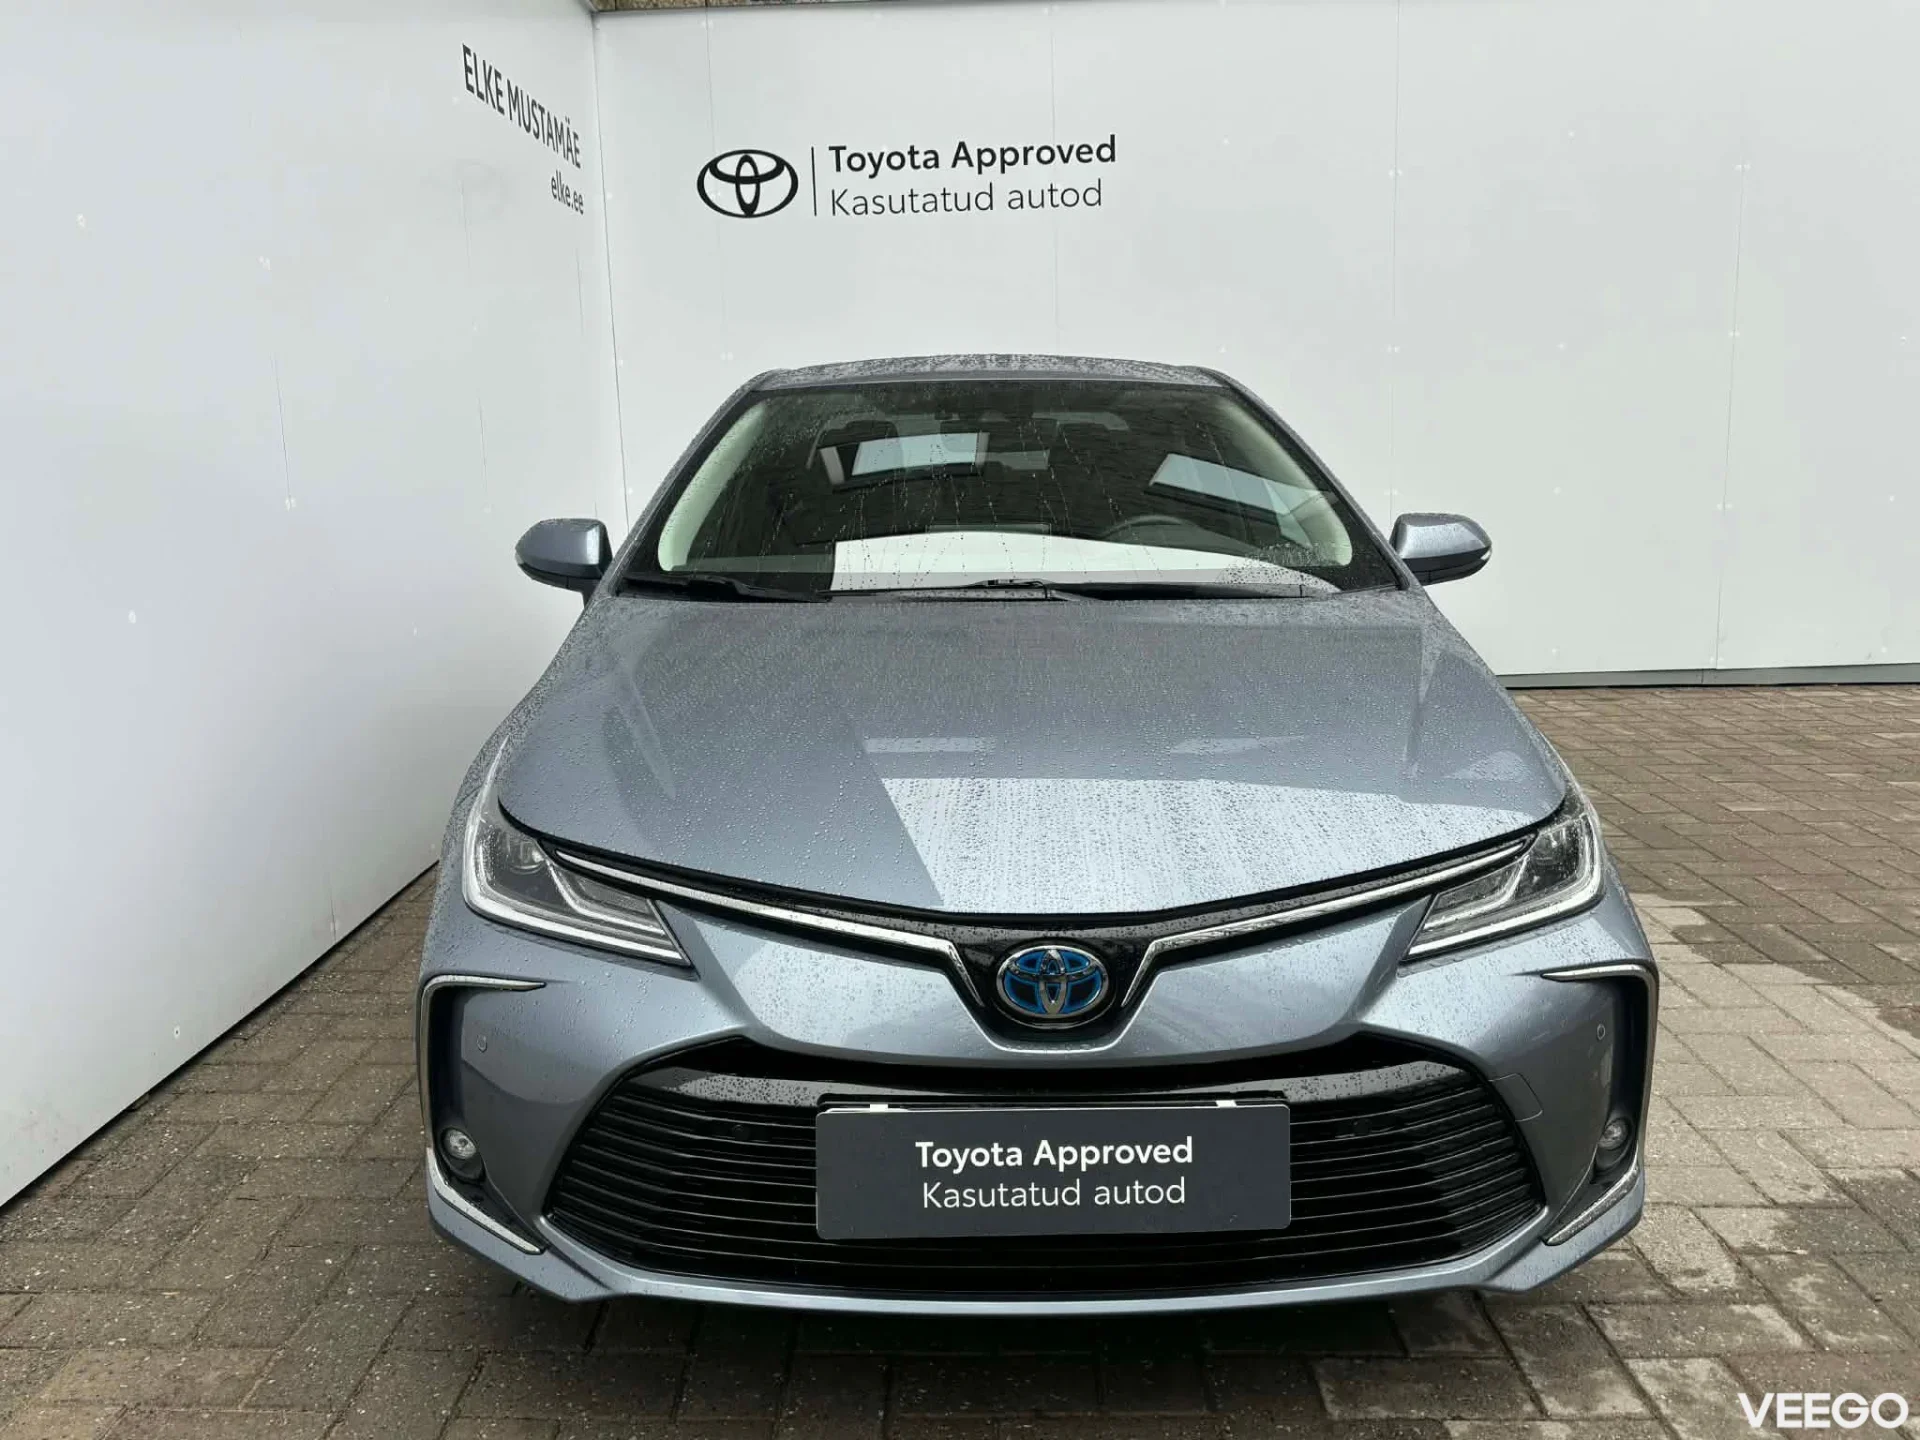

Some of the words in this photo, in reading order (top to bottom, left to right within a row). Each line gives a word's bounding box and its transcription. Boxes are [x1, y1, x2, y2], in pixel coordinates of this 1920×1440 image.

[462, 43, 505, 116] ELKE
[507, 78, 581, 169] MUSTAMÄE
[828, 145, 940, 178] Toyota
[951, 134, 1117, 174] Approved
[551, 169, 584, 215] elke.ee
[831, 182, 994, 216] Kasutatud
[1007, 178, 1102, 210] autod
[915, 1140, 1023, 1174] Toyota
[1033, 1136, 1193, 1172] Approved
[923, 1178, 1081, 1209] Kasutatud
[1094, 1177, 1186, 1204] autod
